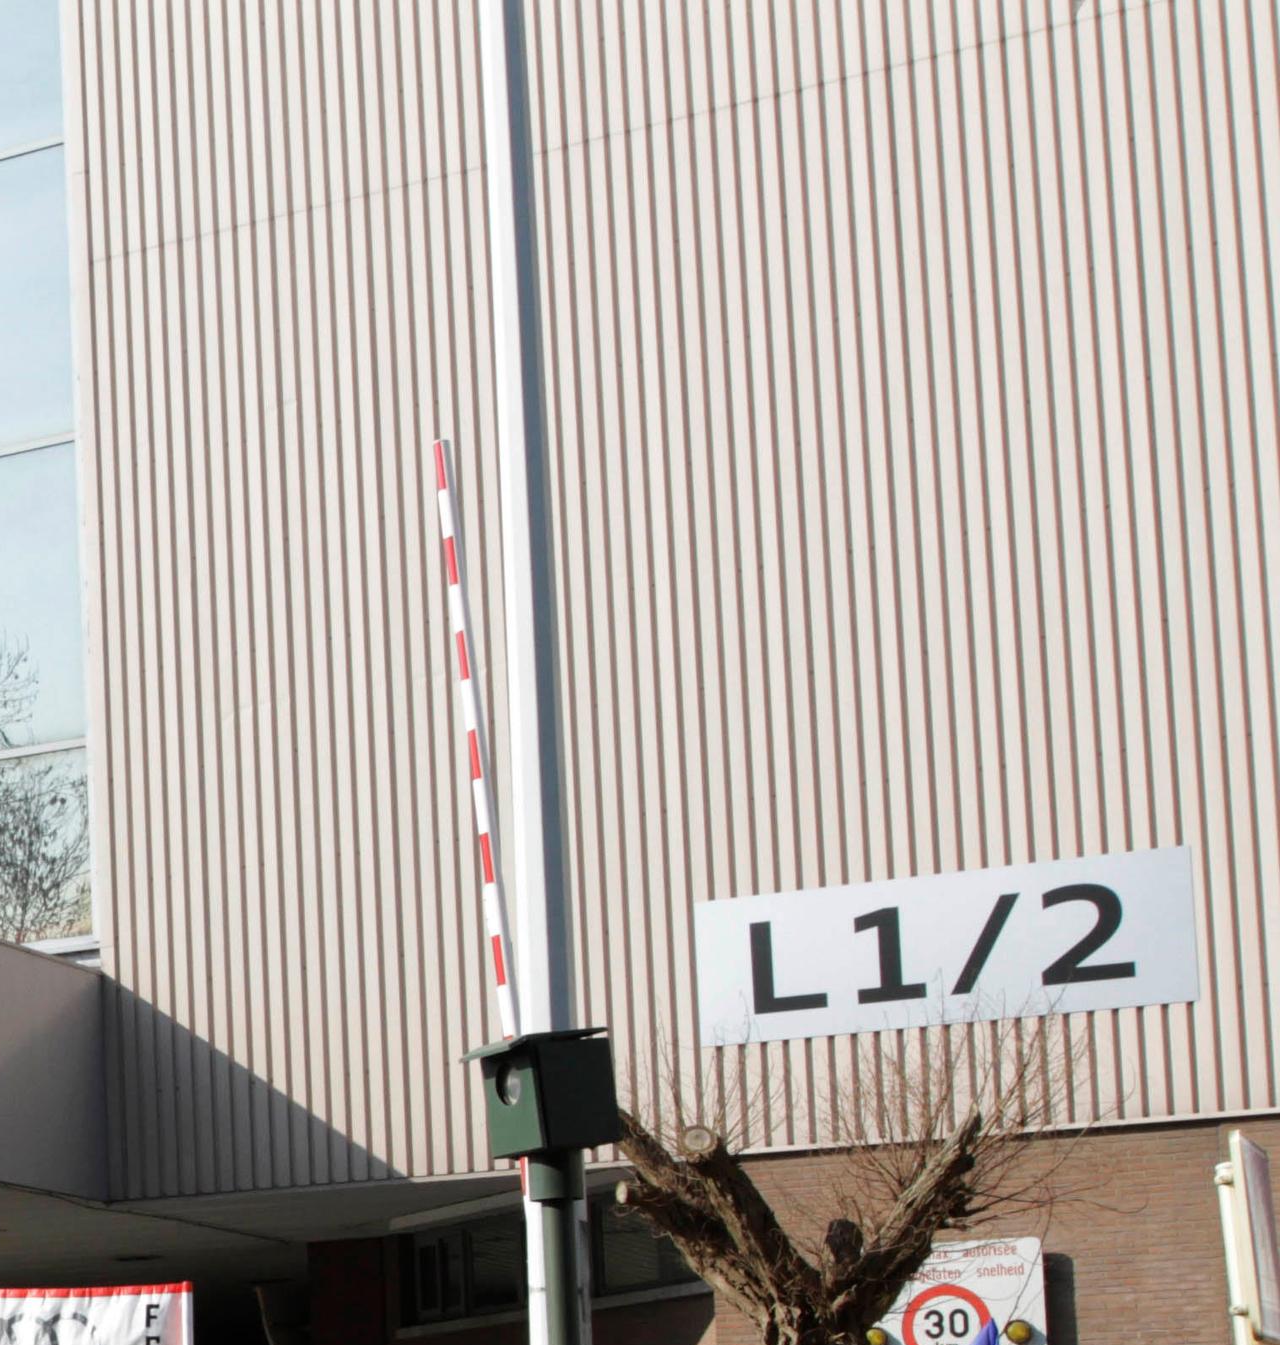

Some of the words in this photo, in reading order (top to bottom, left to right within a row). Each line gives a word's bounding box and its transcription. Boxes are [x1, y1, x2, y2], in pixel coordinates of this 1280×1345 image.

[748, 882, 1136, 1016] L1/2
[976, 1263, 1025, 1278] snelheid
[924, 1308, 970, 1339] 30
